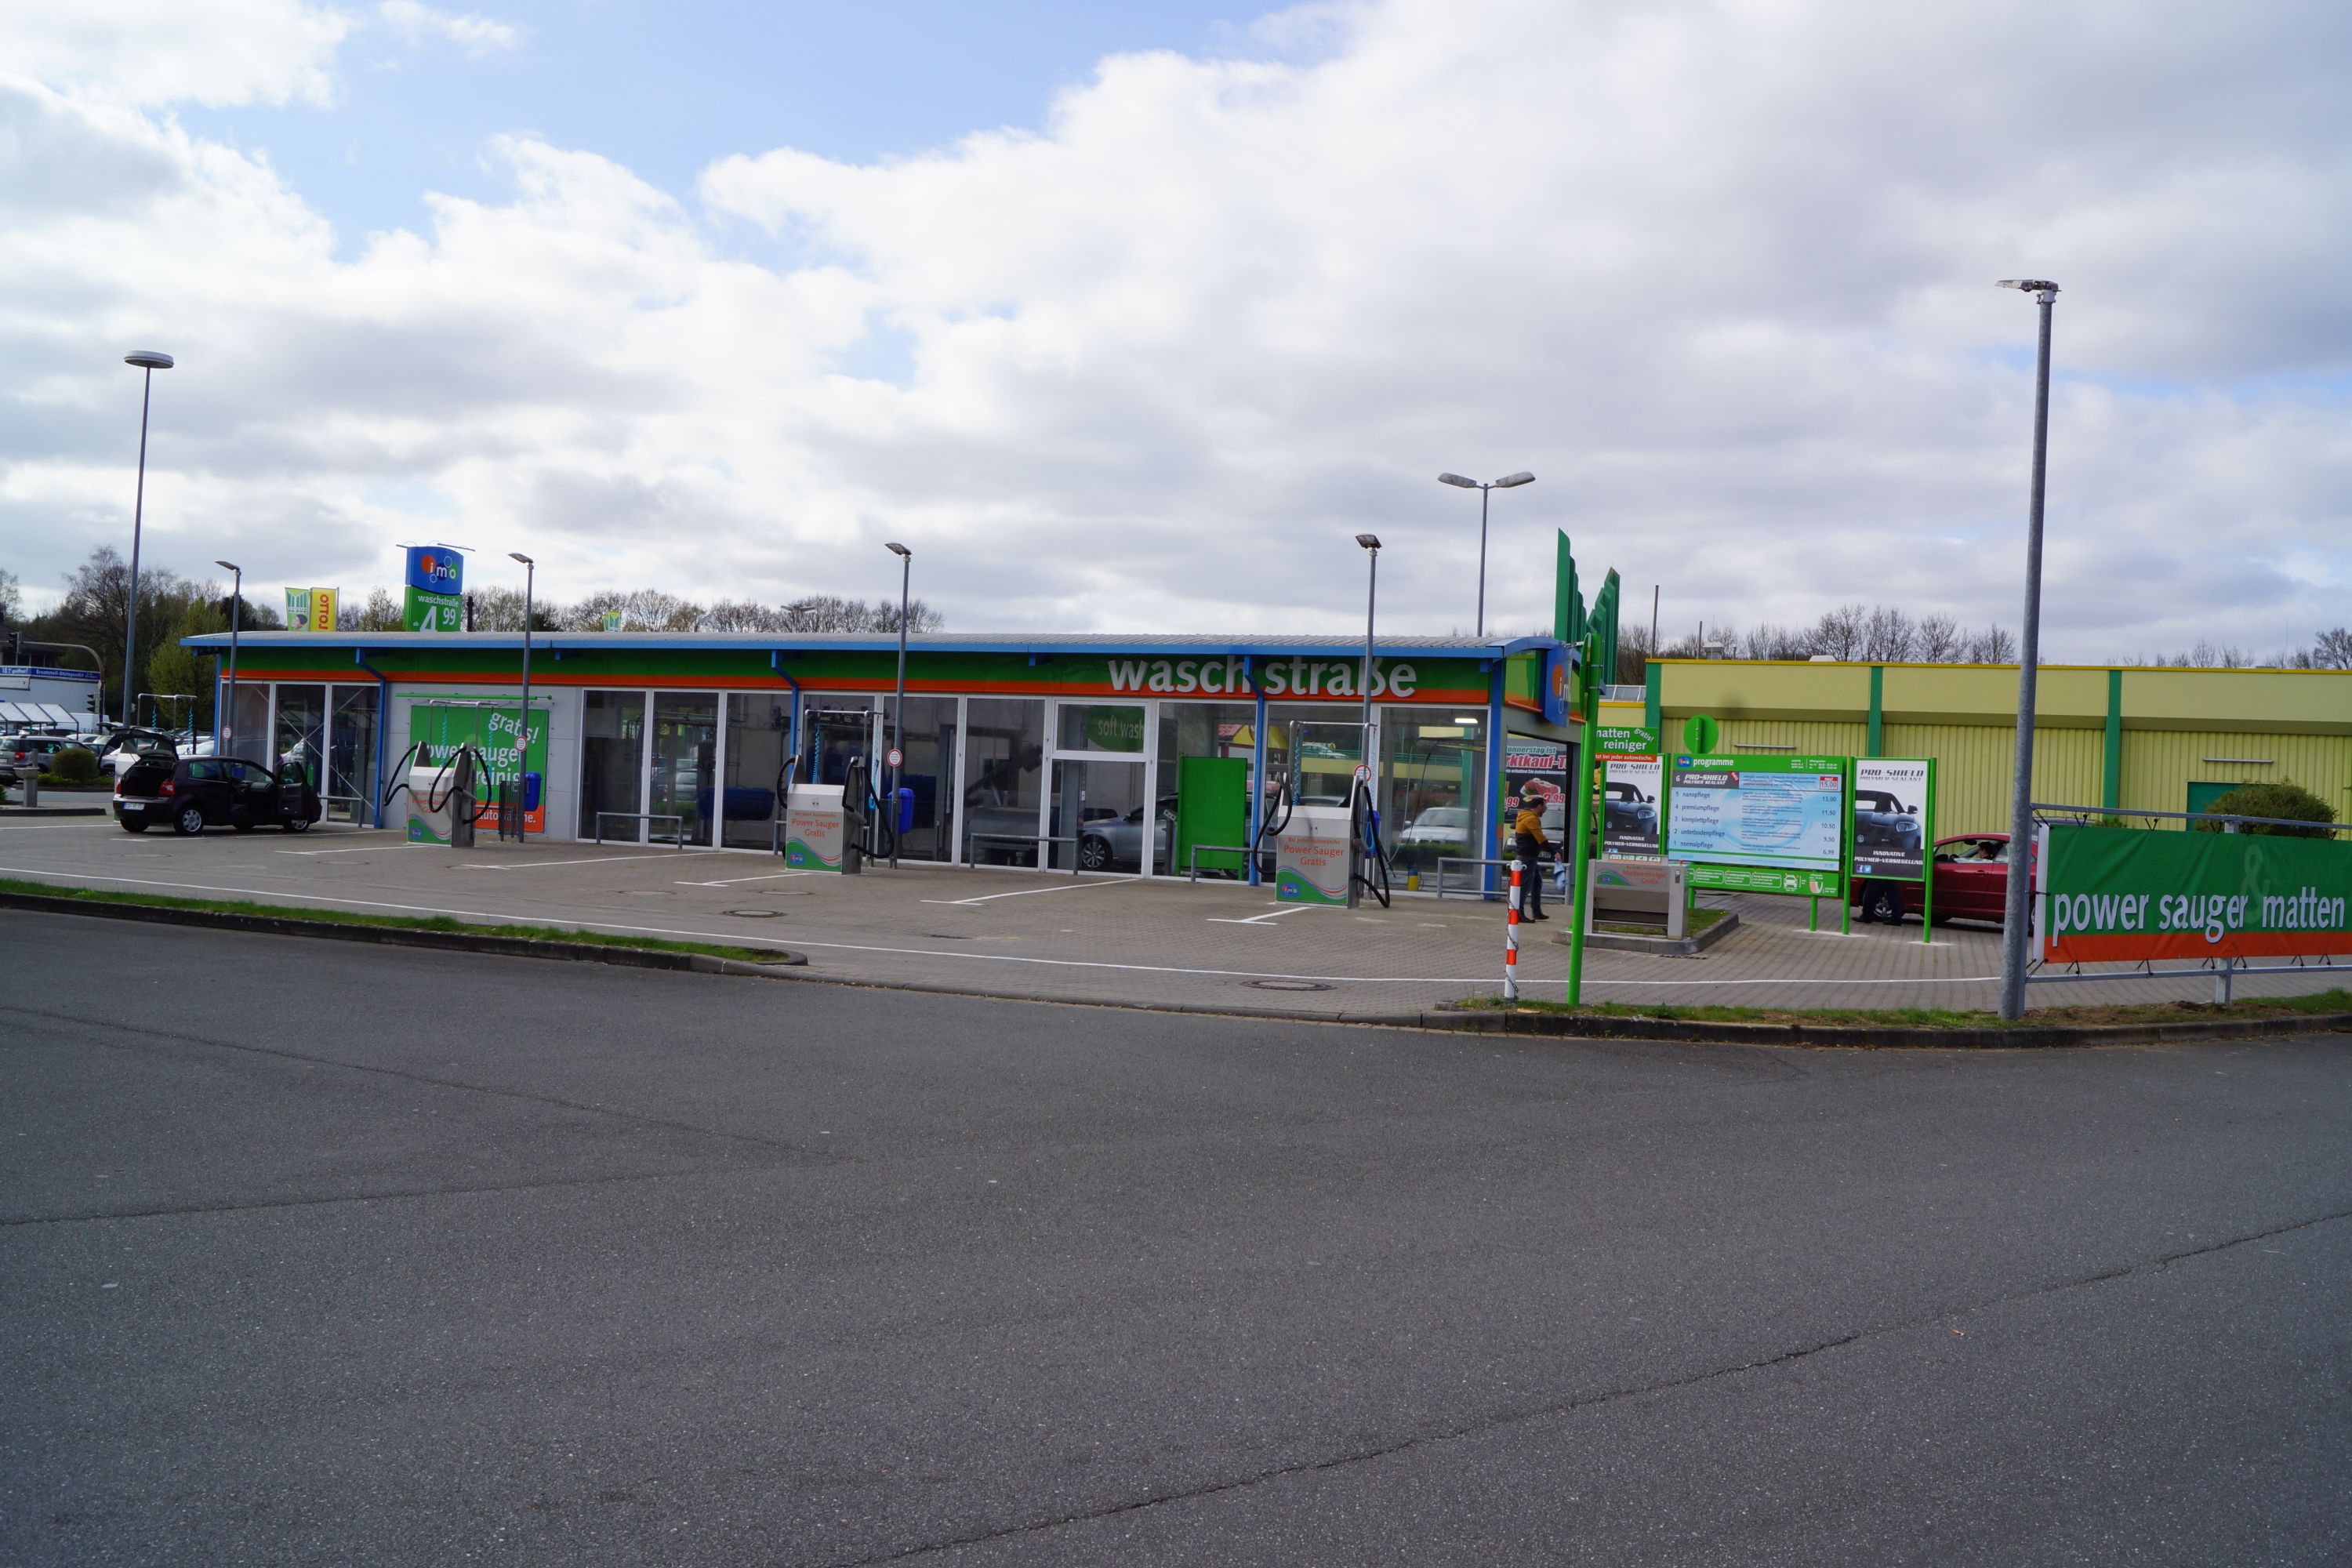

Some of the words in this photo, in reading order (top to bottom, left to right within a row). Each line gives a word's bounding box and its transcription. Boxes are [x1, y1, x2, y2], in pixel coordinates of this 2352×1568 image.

[429, 562, 456, 579] imo
[418, 596, 459, 608] waschstraße
[318, 594, 329, 630] LOTTO
[443, 607, 456, 626] 99
[1559, 677, 1571, 703] im
[488, 712, 539, 744] grats!
[1098, 714, 1118, 737] soft
[1120, 717, 1145, 740] wash
[1634, 728, 1654, 742] gratis!
[1507, 746, 1545, 755] onnerstag
[1545, 746, 1557, 755] ist
[1603, 739, 1647, 753] reiniger
[1693, 758, 1734, 768] programme
[792, 818, 813, 827] Power
[815, 819, 841, 829] Sauger
[804, 828, 826, 837] Gratis
[1283, 844, 1312, 854] Power
[1313, 846, 1345, 858] Sauger
[1300, 857, 1327, 866] Gratis
[2052, 893, 2150, 948] power
[2158, 892, 2249, 944] sauger
[2261, 886, 2347, 929] matten
